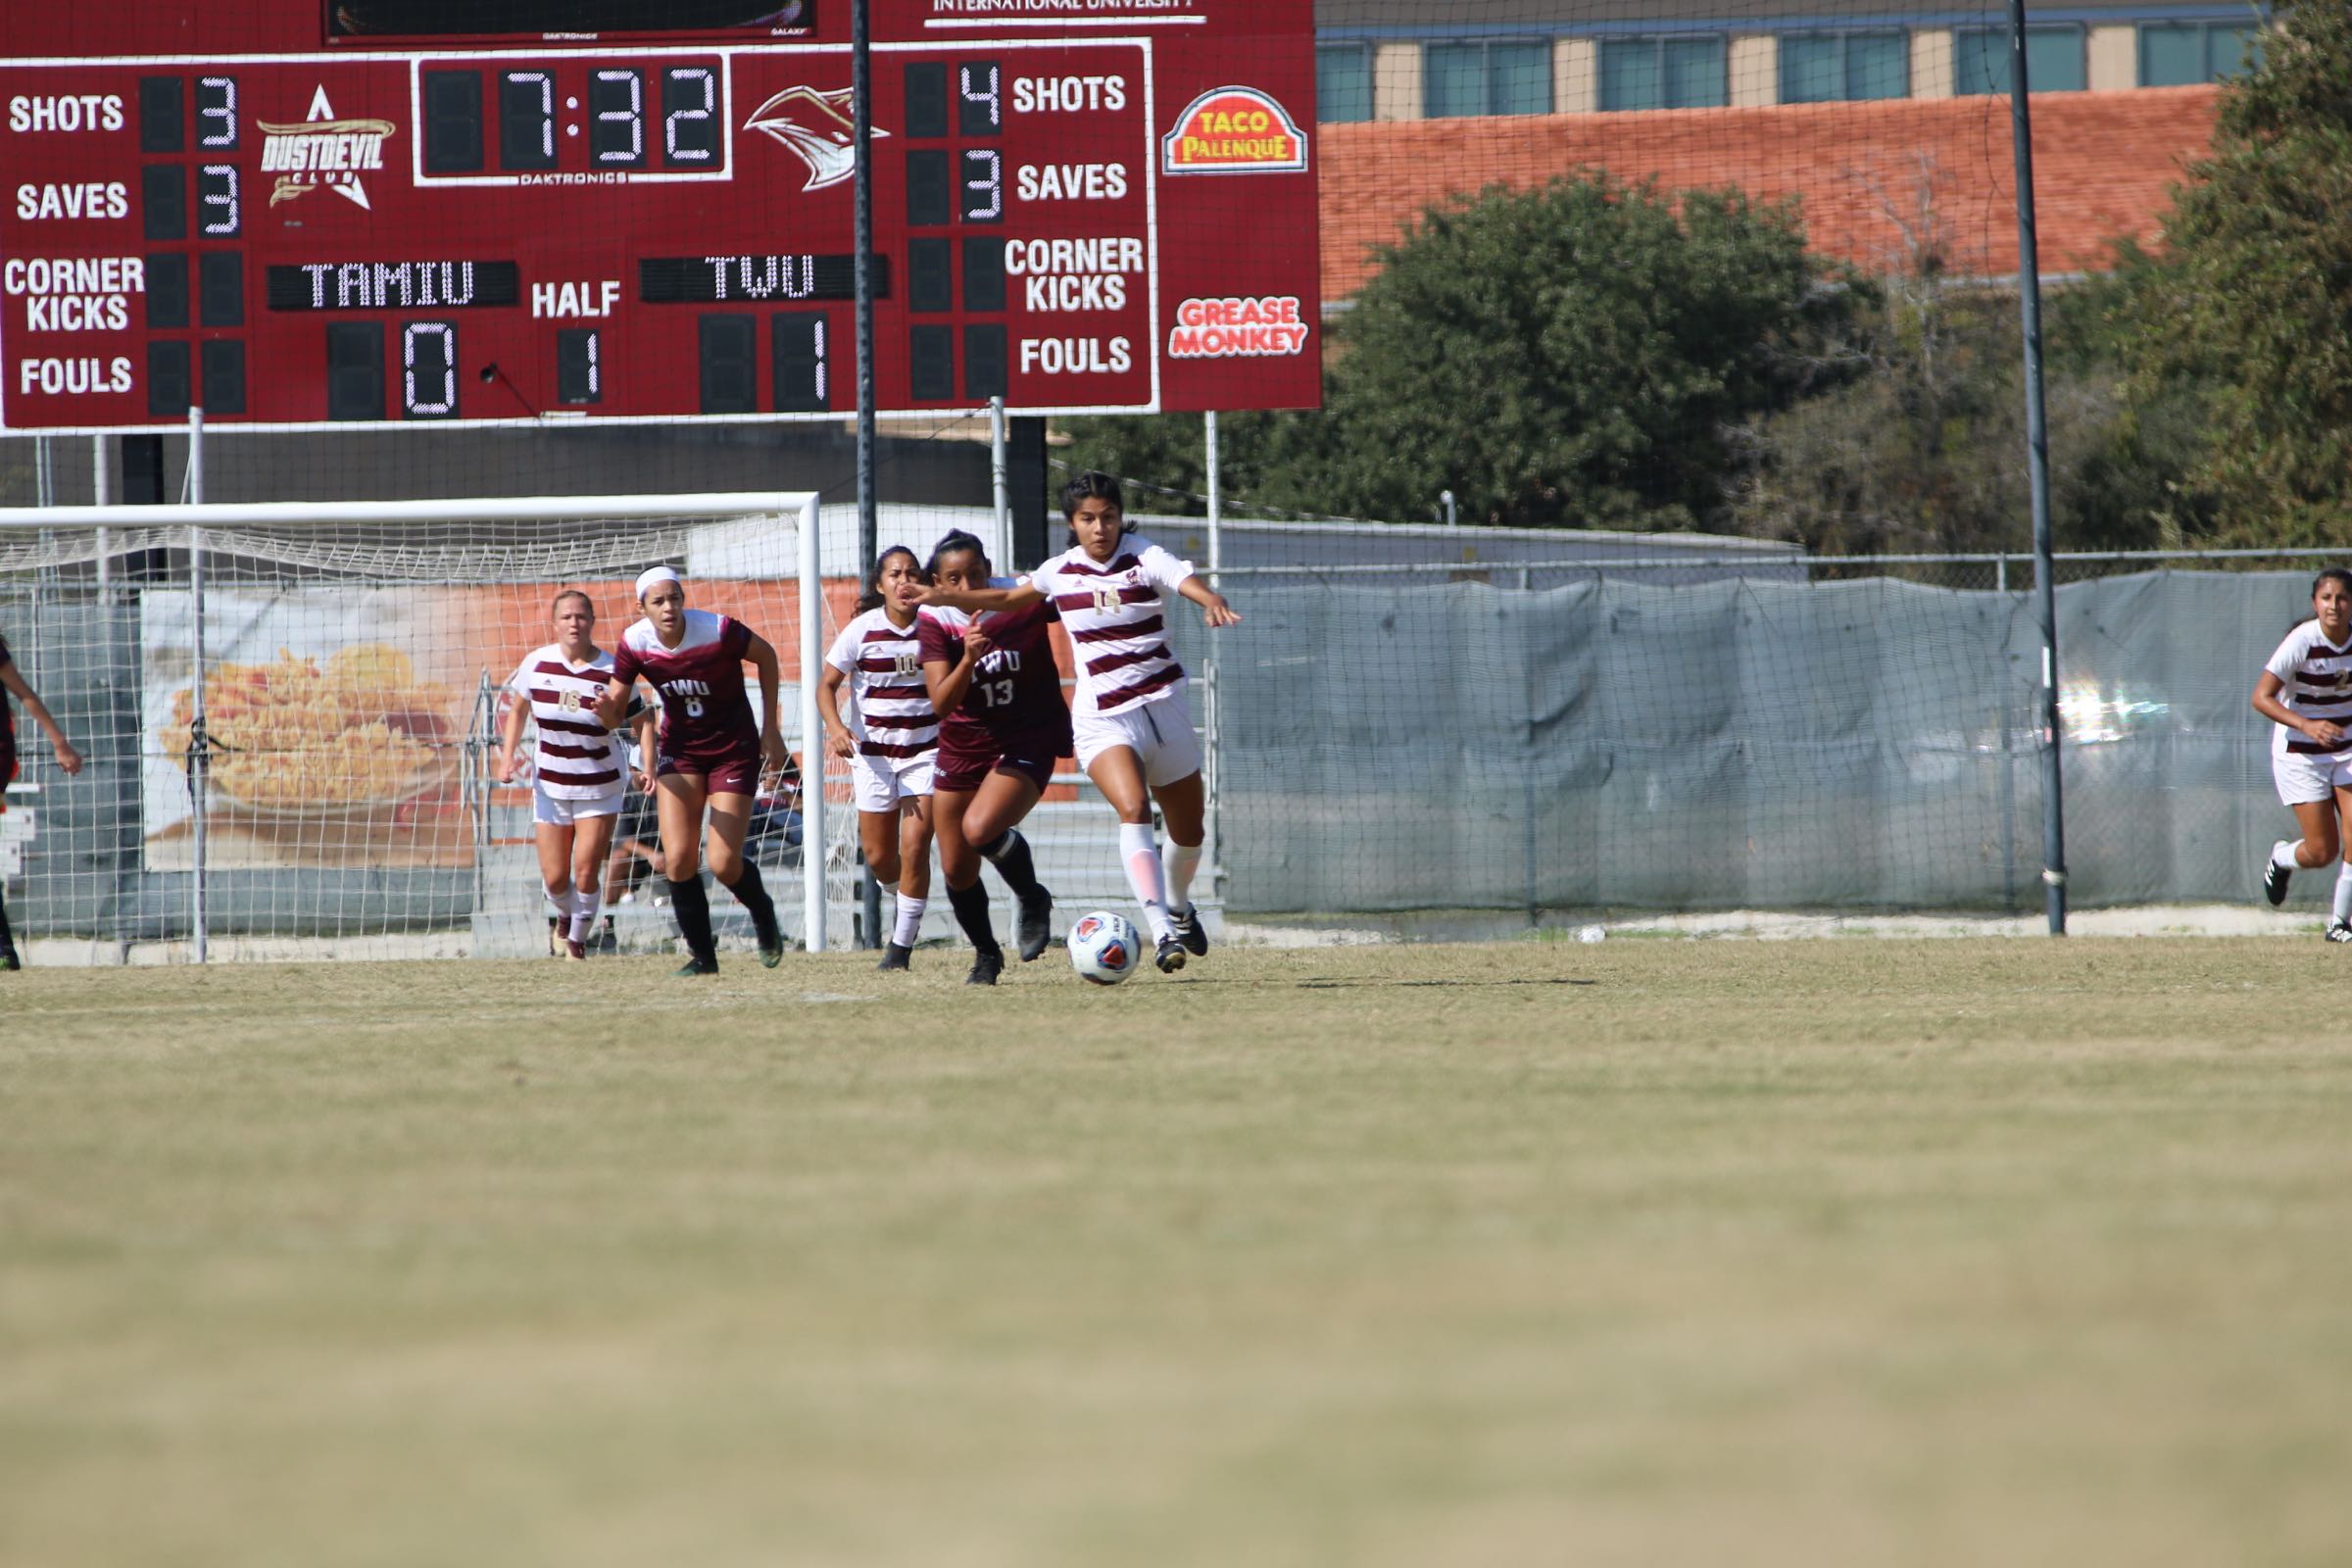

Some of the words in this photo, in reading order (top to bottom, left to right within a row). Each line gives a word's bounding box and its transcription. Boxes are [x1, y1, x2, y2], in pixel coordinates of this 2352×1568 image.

[932, 0, 1083, 11] INTERNATIONAL
[202, 76, 236, 146] 3
[961, 66, 1000, 125] 4
[1012, 75, 1126, 113] SHOTS
[9, 95, 123, 132] SHOTS
[508, 69, 713, 161] 7:32
[1200, 111, 1269, 133] TACO
[261, 133, 383, 172] DUSTDEVIL
[1182, 135, 1288, 162] PALENQUE
[292, 171, 353, 184] CLUB
[520, 172, 627, 186] DAKTRONICS
[966, 149, 1001, 219] 3
[1017, 164, 1127, 201] SAVES
[17, 182, 128, 220] SAVES
[204, 165, 238, 234] 3
[1004, 238, 1144, 275] CORNER
[4, 258, 145, 295] CORNER
[302, 261, 473, 308] TAMIU
[706, 255, 814, 299] TWU
[1025, 274, 1126, 312] KICKS
[26, 295, 128, 332] KICKS
[531, 280, 620, 318] HALF
[1178, 297, 1299, 326] GREASE
[813, 319, 825, 401] 1
[1020, 336, 1131, 374] FOULS
[1169, 324, 1308, 359] MONKEY
[21, 357, 132, 395] FOULS
[405, 321, 455, 415] 0
[587, 333, 598, 394] 1
[1093, 585, 1121, 615] 14
[895, 652, 917, 677] 10
[2334, 668, 2349, 692] 2
[559, 688, 581, 713] 16
[660, 678, 711, 697] TWU
[980, 678, 1013, 708] 13
[685, 697, 704, 717] 8
